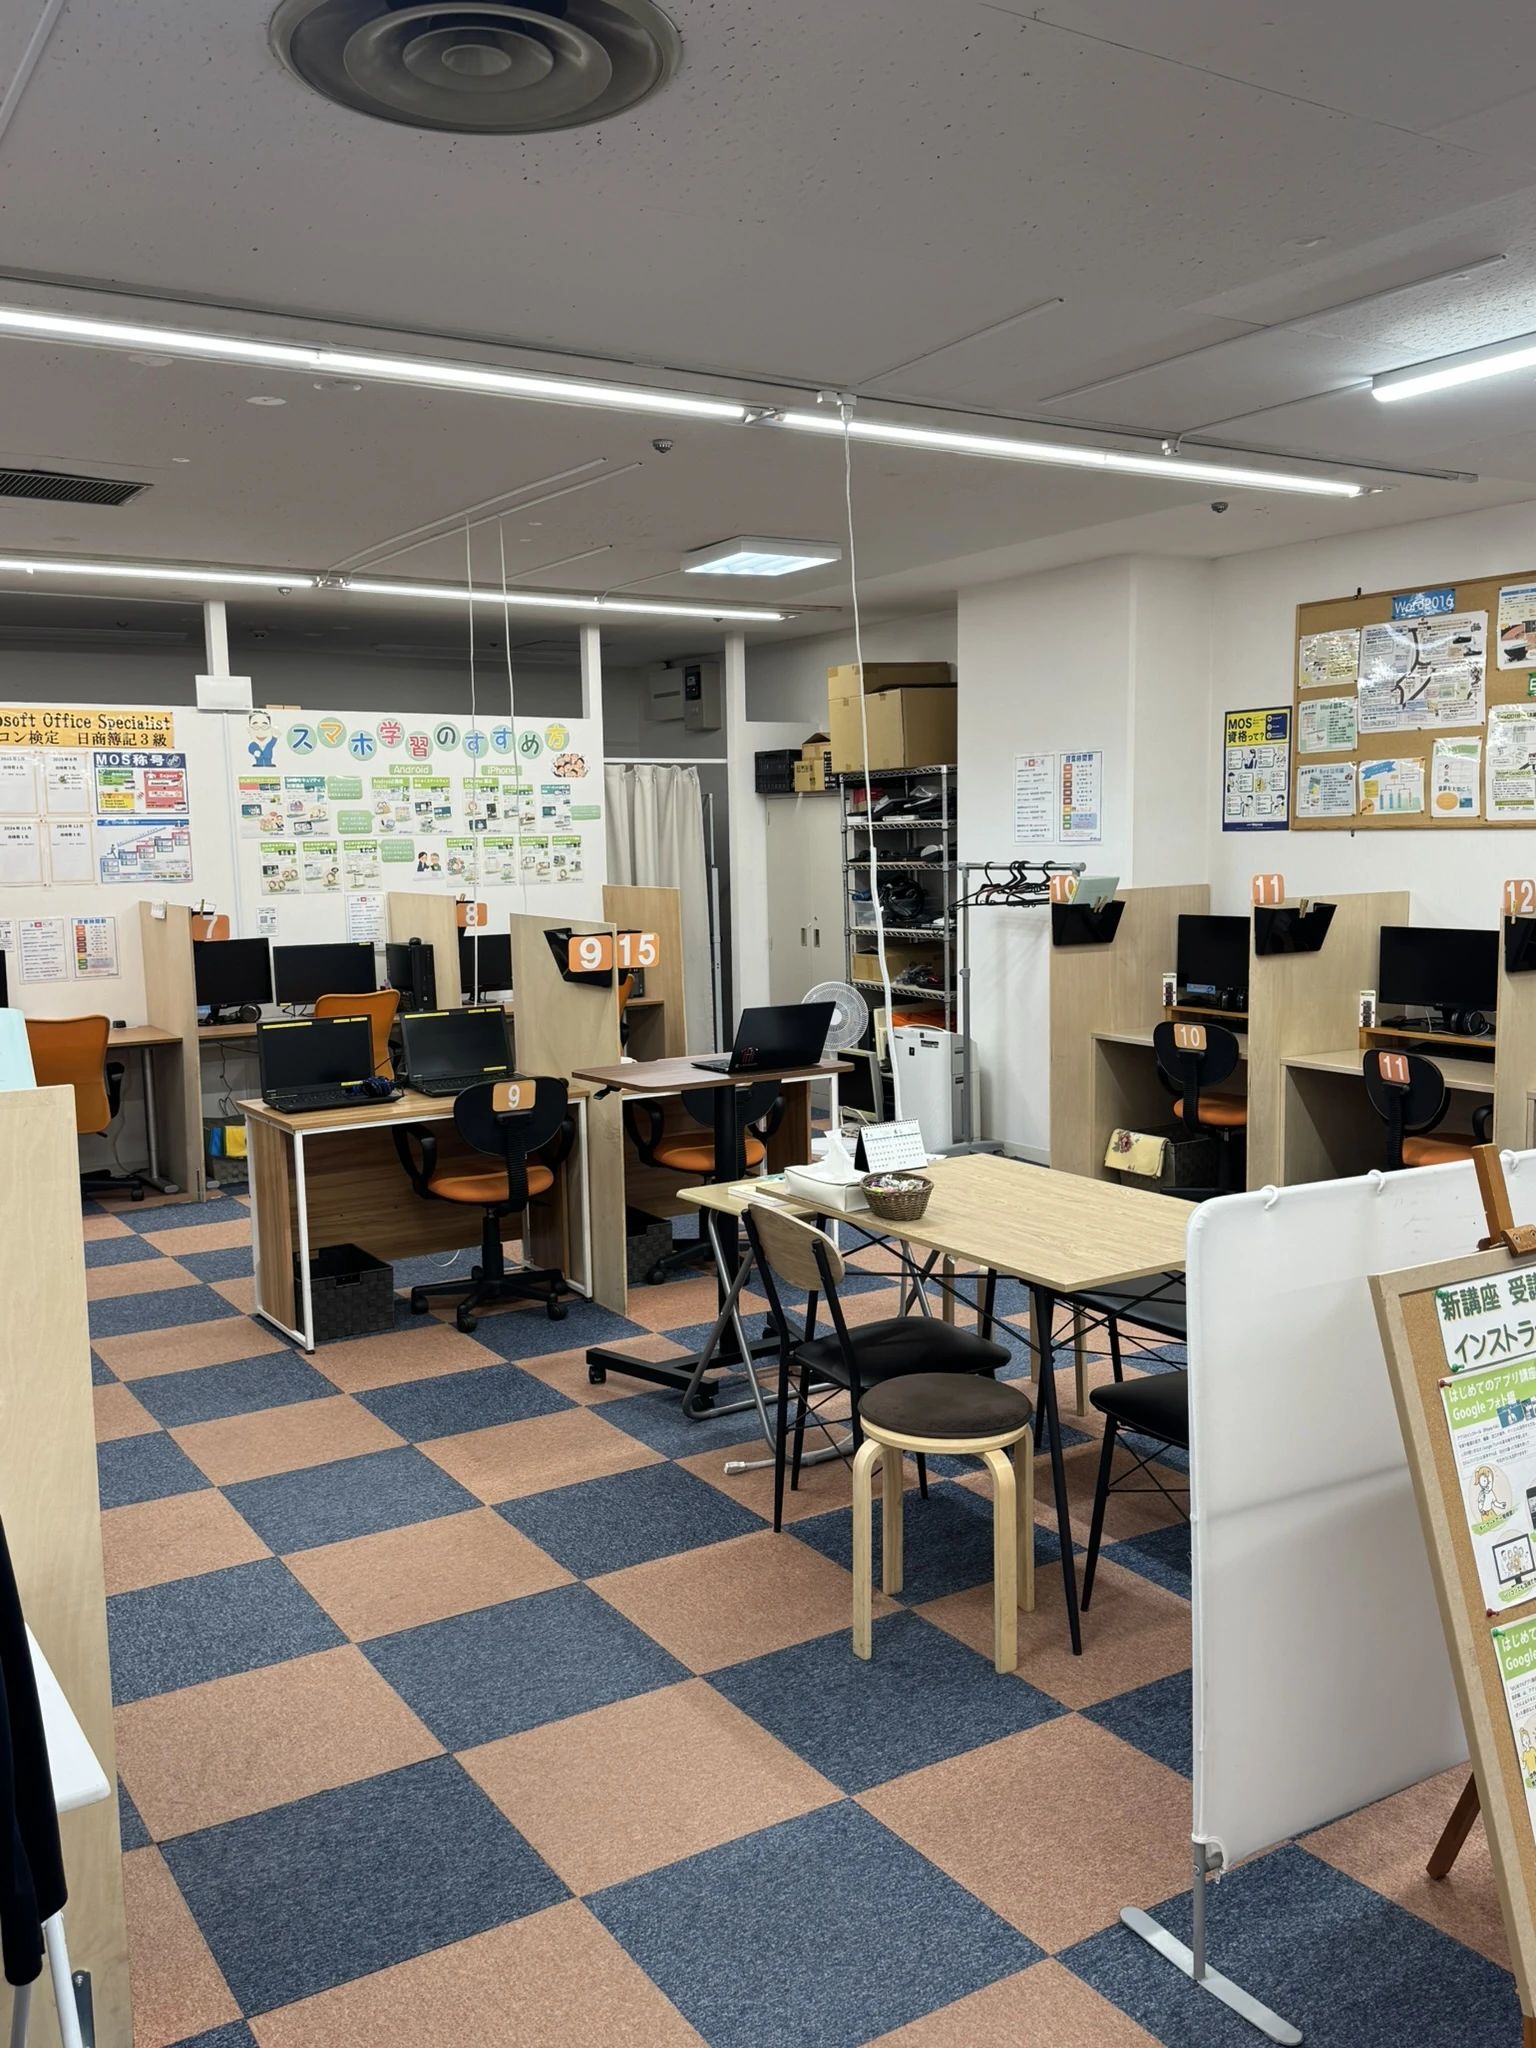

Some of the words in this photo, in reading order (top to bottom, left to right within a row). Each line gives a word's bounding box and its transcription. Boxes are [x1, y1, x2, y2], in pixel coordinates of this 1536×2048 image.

[43, 712, 92, 729] Office
[98, 713, 171, 731] Specialist
[1228, 718, 1253, 730] MOS
[394, 766, 429, 774] Android
[487, 766, 516, 775] iPhone
[1256, 876, 1282, 904] 11
[1507, 881, 1534, 912] 12
[465, 904, 478, 925] 8
[203, 915, 218, 940] 7
[580, 937, 602, 969] 9
[619, 935, 656, 966] 15
[1180, 1025, 1200, 1047] 10
[1382, 1056, 1405, 1081] 11
[508, 1085, 520, 1108] 9
[1440, 1283, 1502, 1321] 新講座
[1454, 1319, 1536, 1363] インストラ
[1453, 1401, 1486, 1421] Google
[1506, 1648, 1536, 1671] Google
